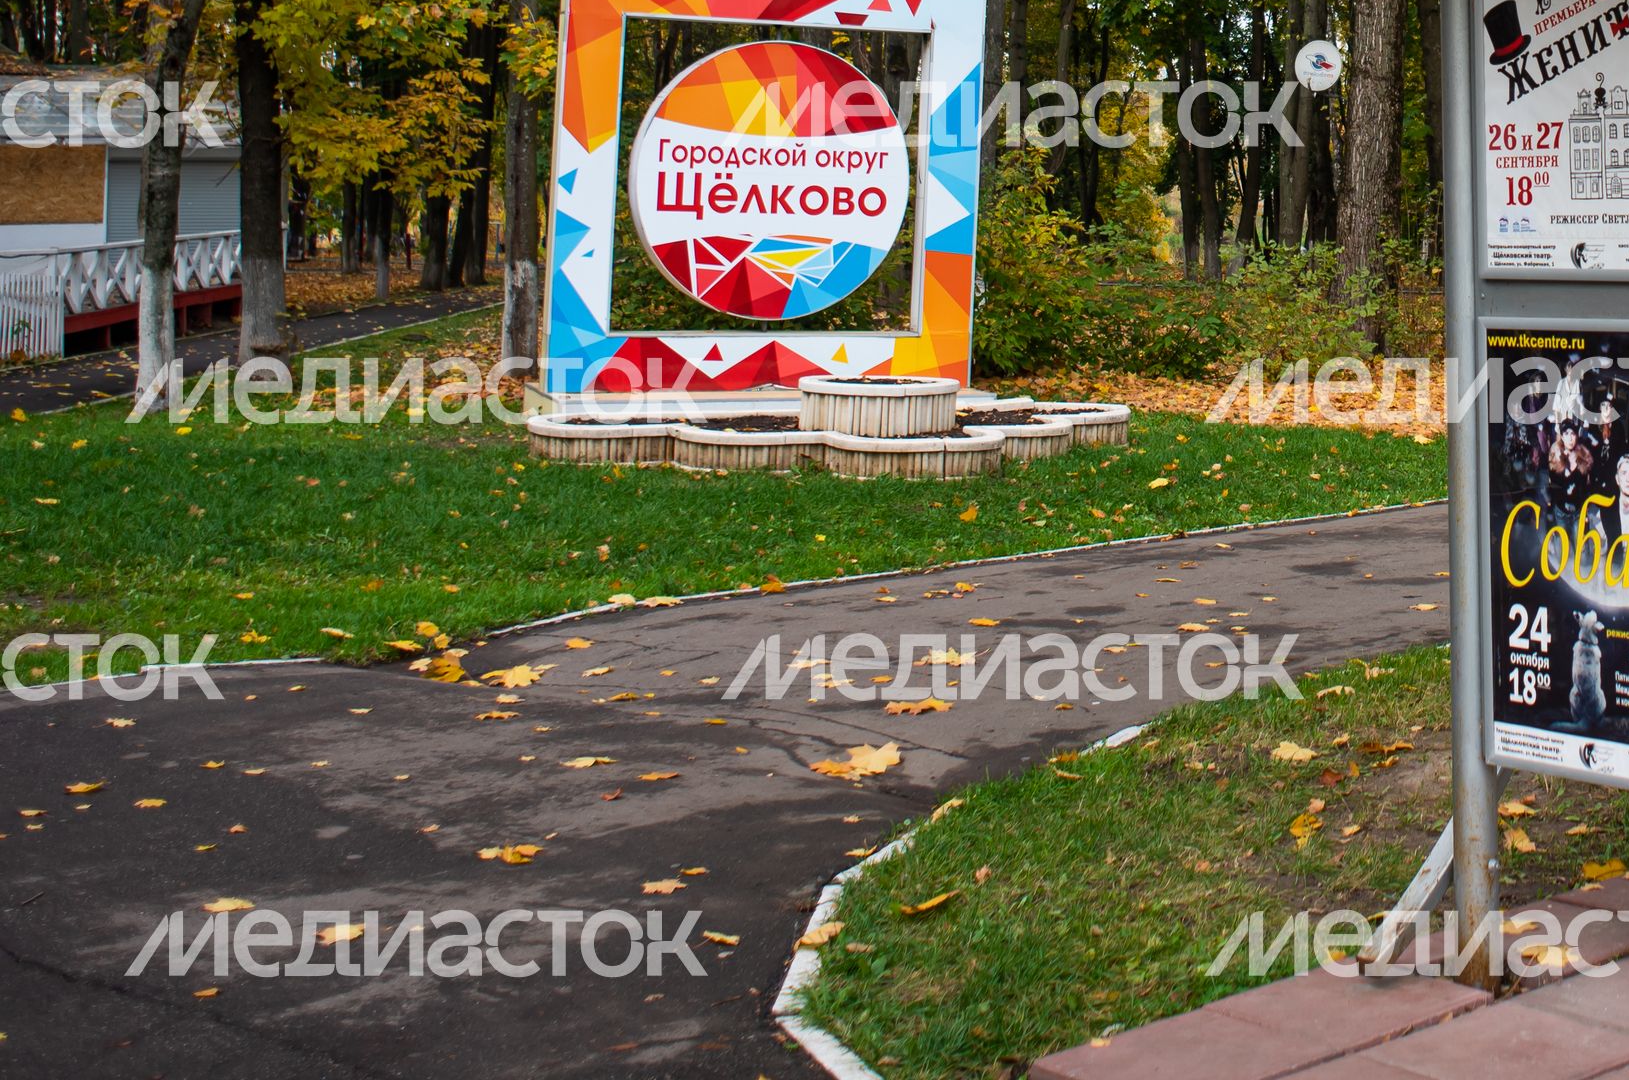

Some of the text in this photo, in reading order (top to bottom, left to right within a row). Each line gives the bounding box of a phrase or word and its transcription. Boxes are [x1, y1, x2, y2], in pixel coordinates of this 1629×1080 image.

[1488, 121, 1563, 151] 26 и 27
[659, 137, 889, 175] Городской округ
[1496, 155, 1559, 169] СЕНТЯБРЯ
[656, 170, 888, 221] Щёлково
[1487, 334, 1585, 350] www.tkcentre.ru
[1508, 603, 1552, 653] 24
[1510, 651, 1550, 670] октября
